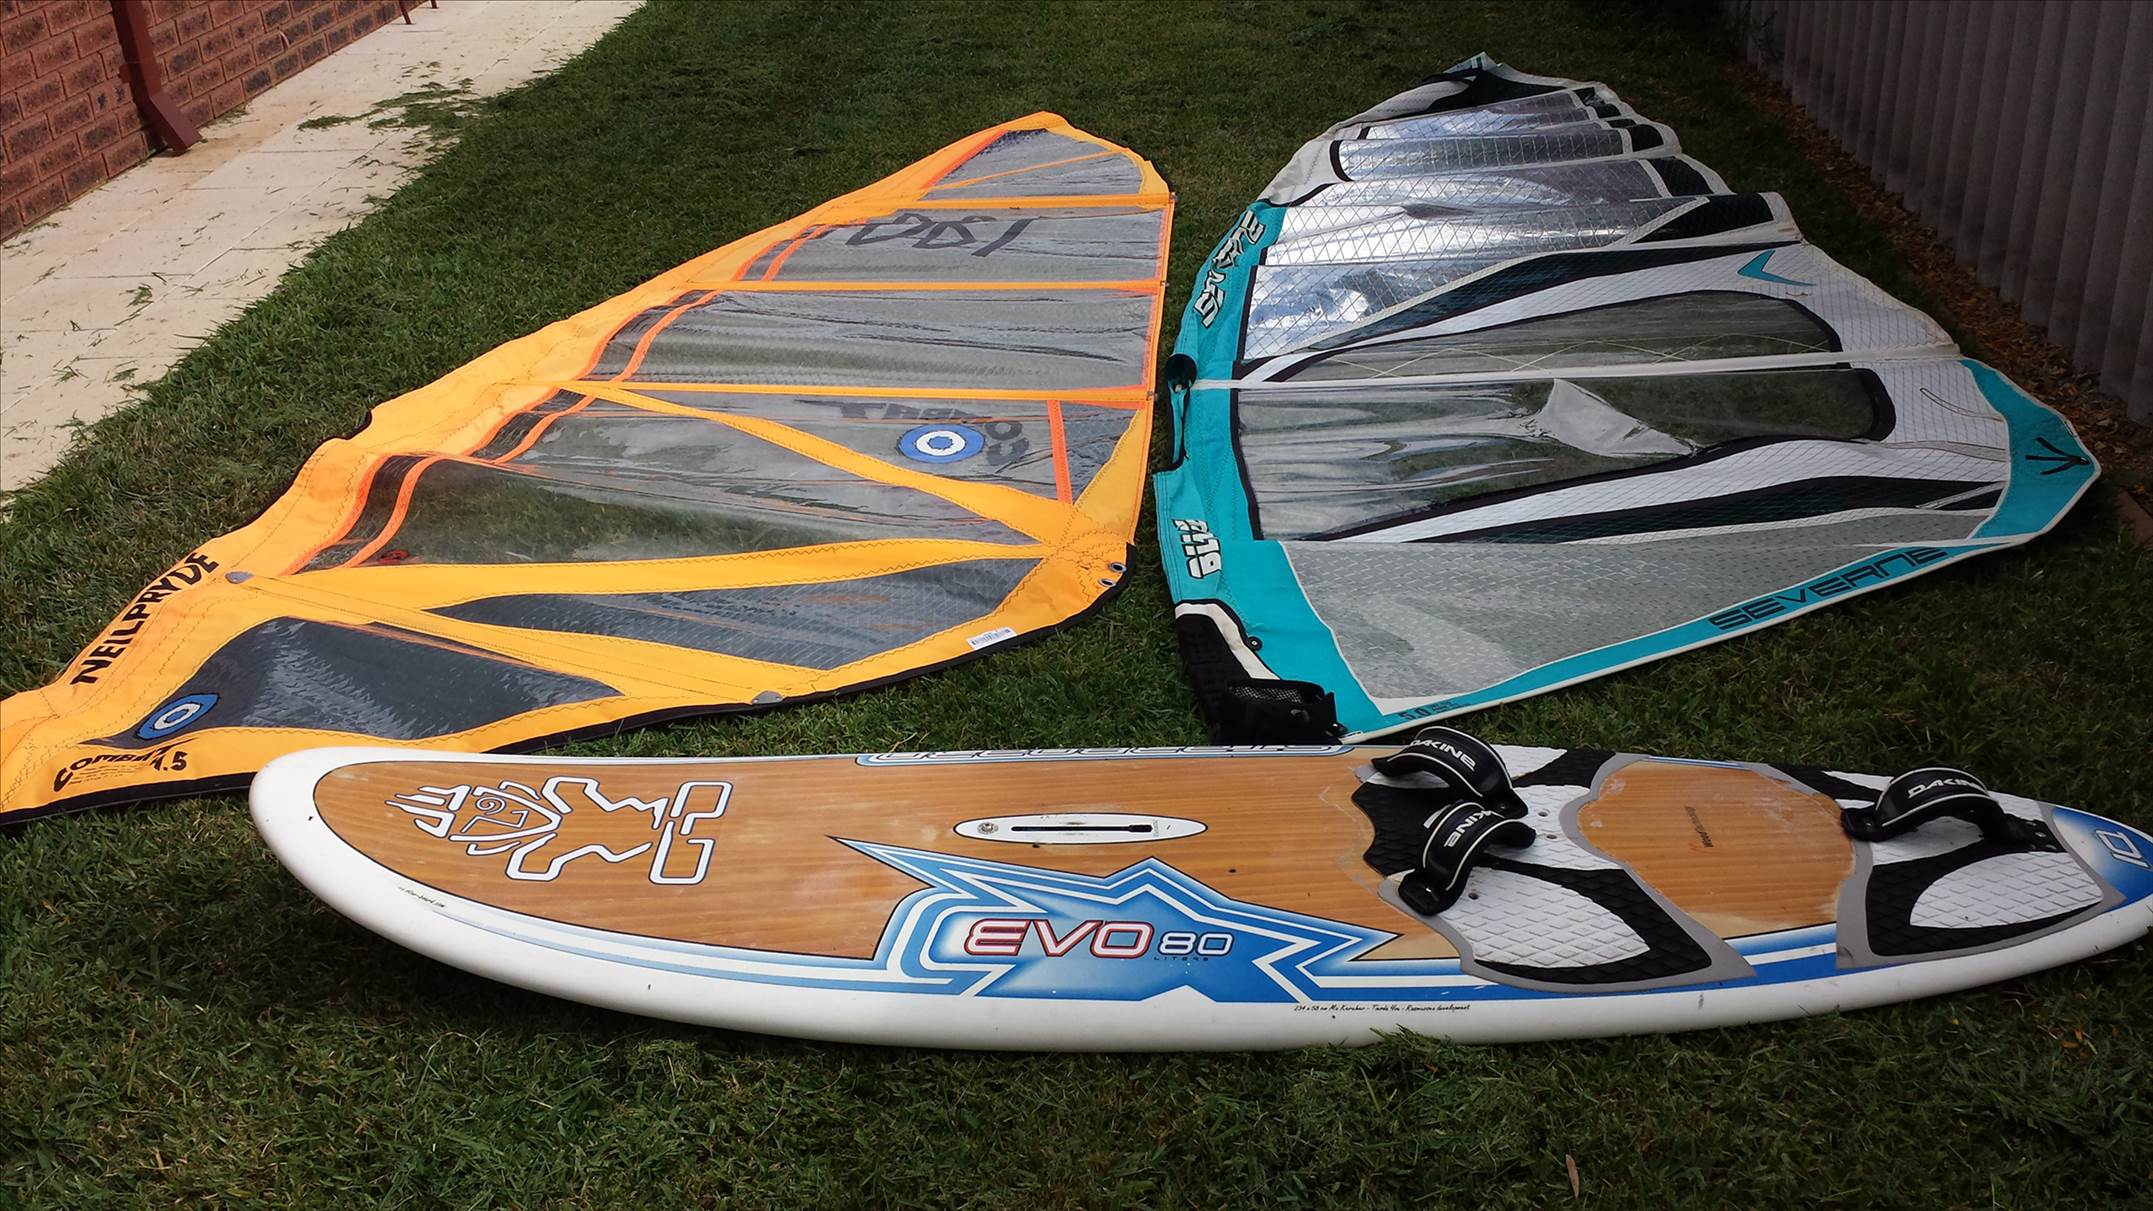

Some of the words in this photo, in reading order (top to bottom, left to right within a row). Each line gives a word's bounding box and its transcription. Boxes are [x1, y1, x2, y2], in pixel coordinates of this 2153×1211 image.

[1708, 547, 1948, 630] SEVERNE
[70, 552, 219, 685] NEILPRYDE
[53, 737, 199, 792] COMBAT
[1411, 739, 1476, 771] DAKINE
[963, 918, 1155, 959] EVO
[1158, 931, 1234, 957] 80
